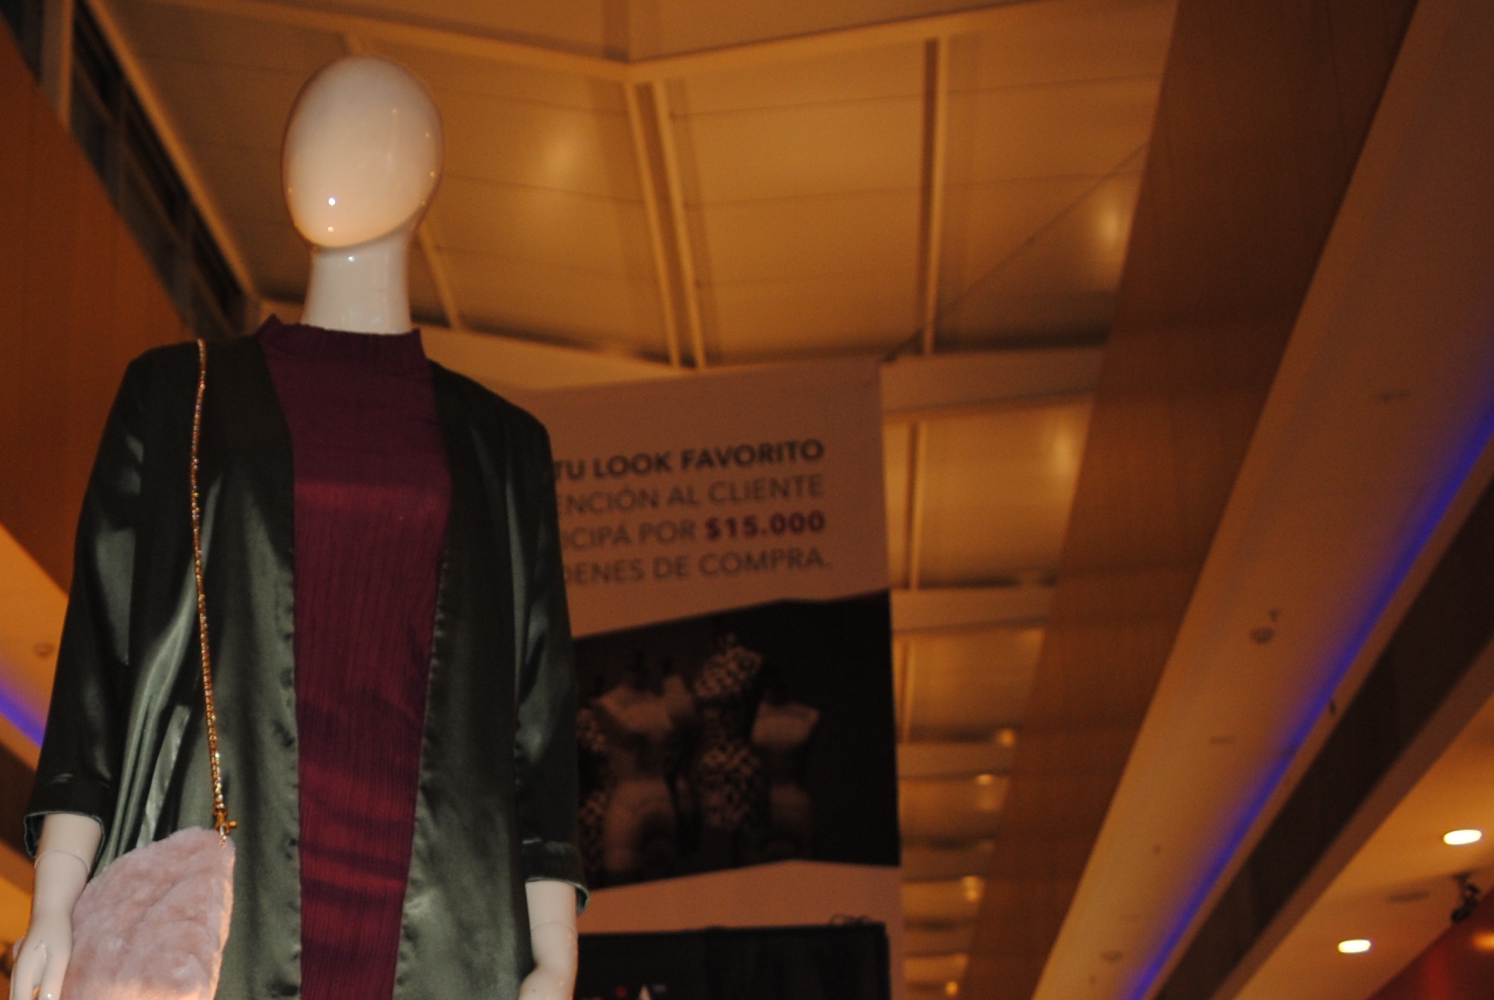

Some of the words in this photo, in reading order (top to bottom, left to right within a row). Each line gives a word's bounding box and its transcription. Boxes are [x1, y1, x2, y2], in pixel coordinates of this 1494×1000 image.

[553, 459, 585, 481] TU
[593, 451, 672, 478] LOOK
[680, 439, 825, 471] FAVORITO
[667, 482, 700, 507] AL
[708, 474, 823, 505] CLIENTE
[638, 519, 696, 546] POR
[705, 510, 826, 542] $15.000
[653, 554, 689, 580] DE
[698, 547, 833, 577] COMPRA.
